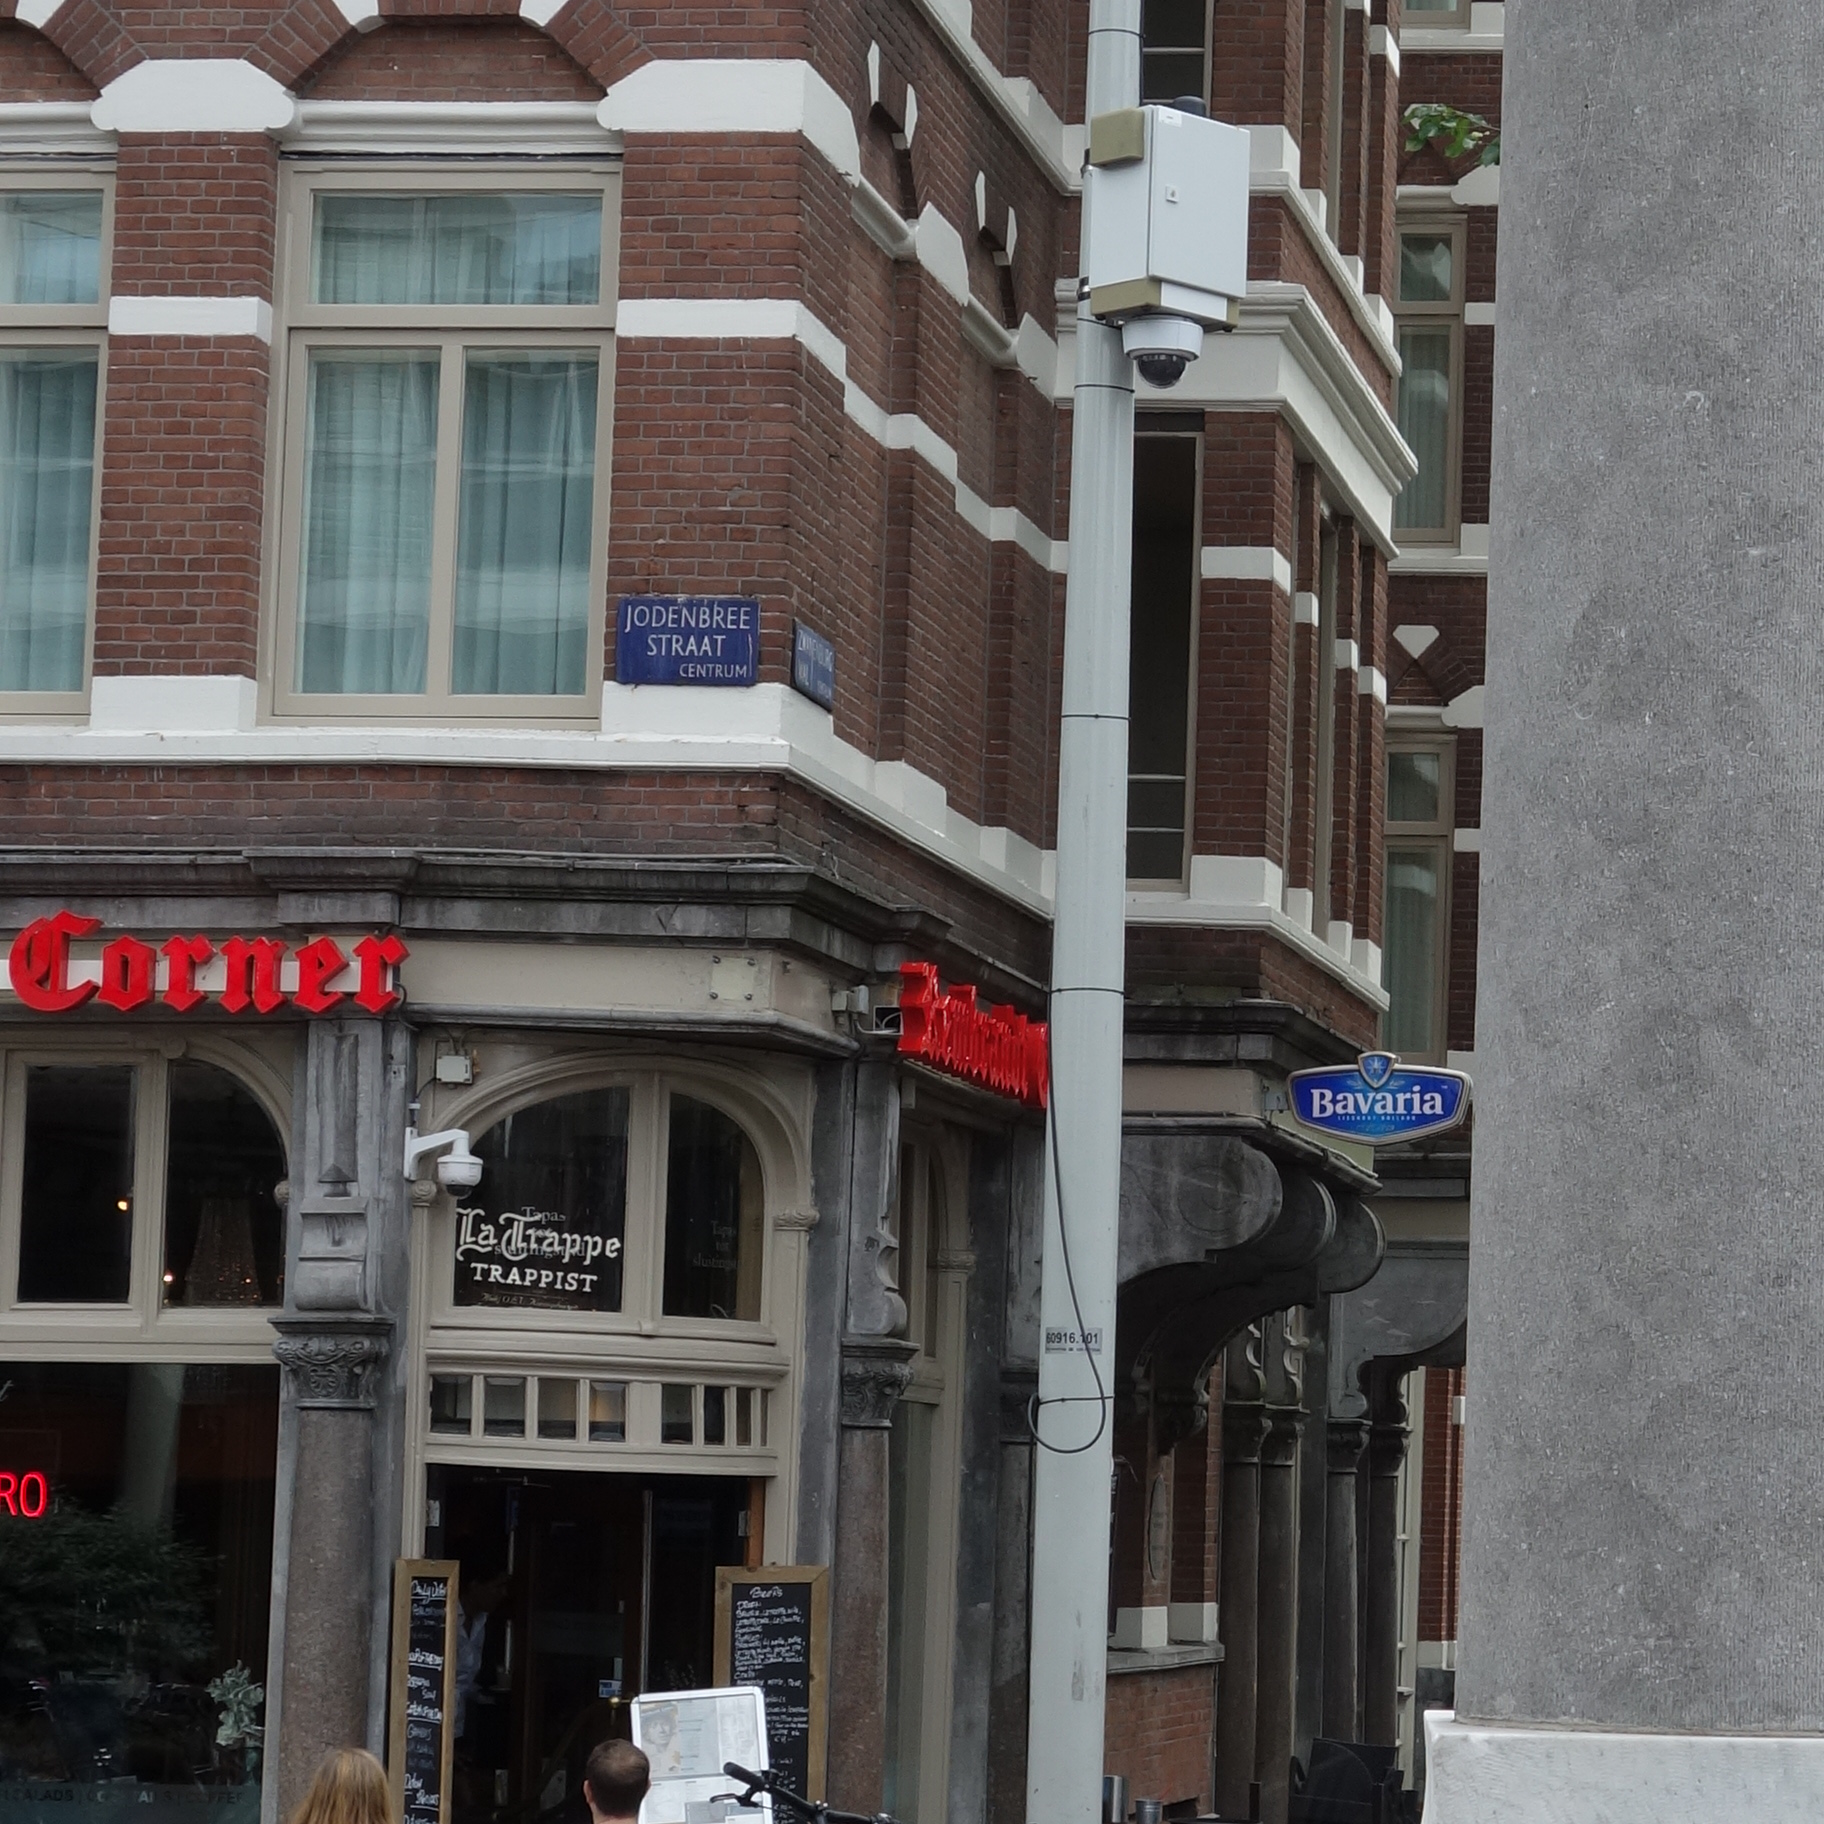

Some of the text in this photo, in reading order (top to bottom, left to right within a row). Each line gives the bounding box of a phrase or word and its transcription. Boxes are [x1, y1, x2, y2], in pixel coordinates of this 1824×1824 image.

[624, 605, 751, 633] JODENBREE
[647, 634, 727, 657] STRAAT
[679, 663, 748, 678] CENTRUM
[8, 909, 411, 1014] Corner
[1310, 1084, 1445, 1118] Bavaria
[498, 1212, 622, 1266] Trappe
[469, 1261, 598, 1293] TRAPPIST
